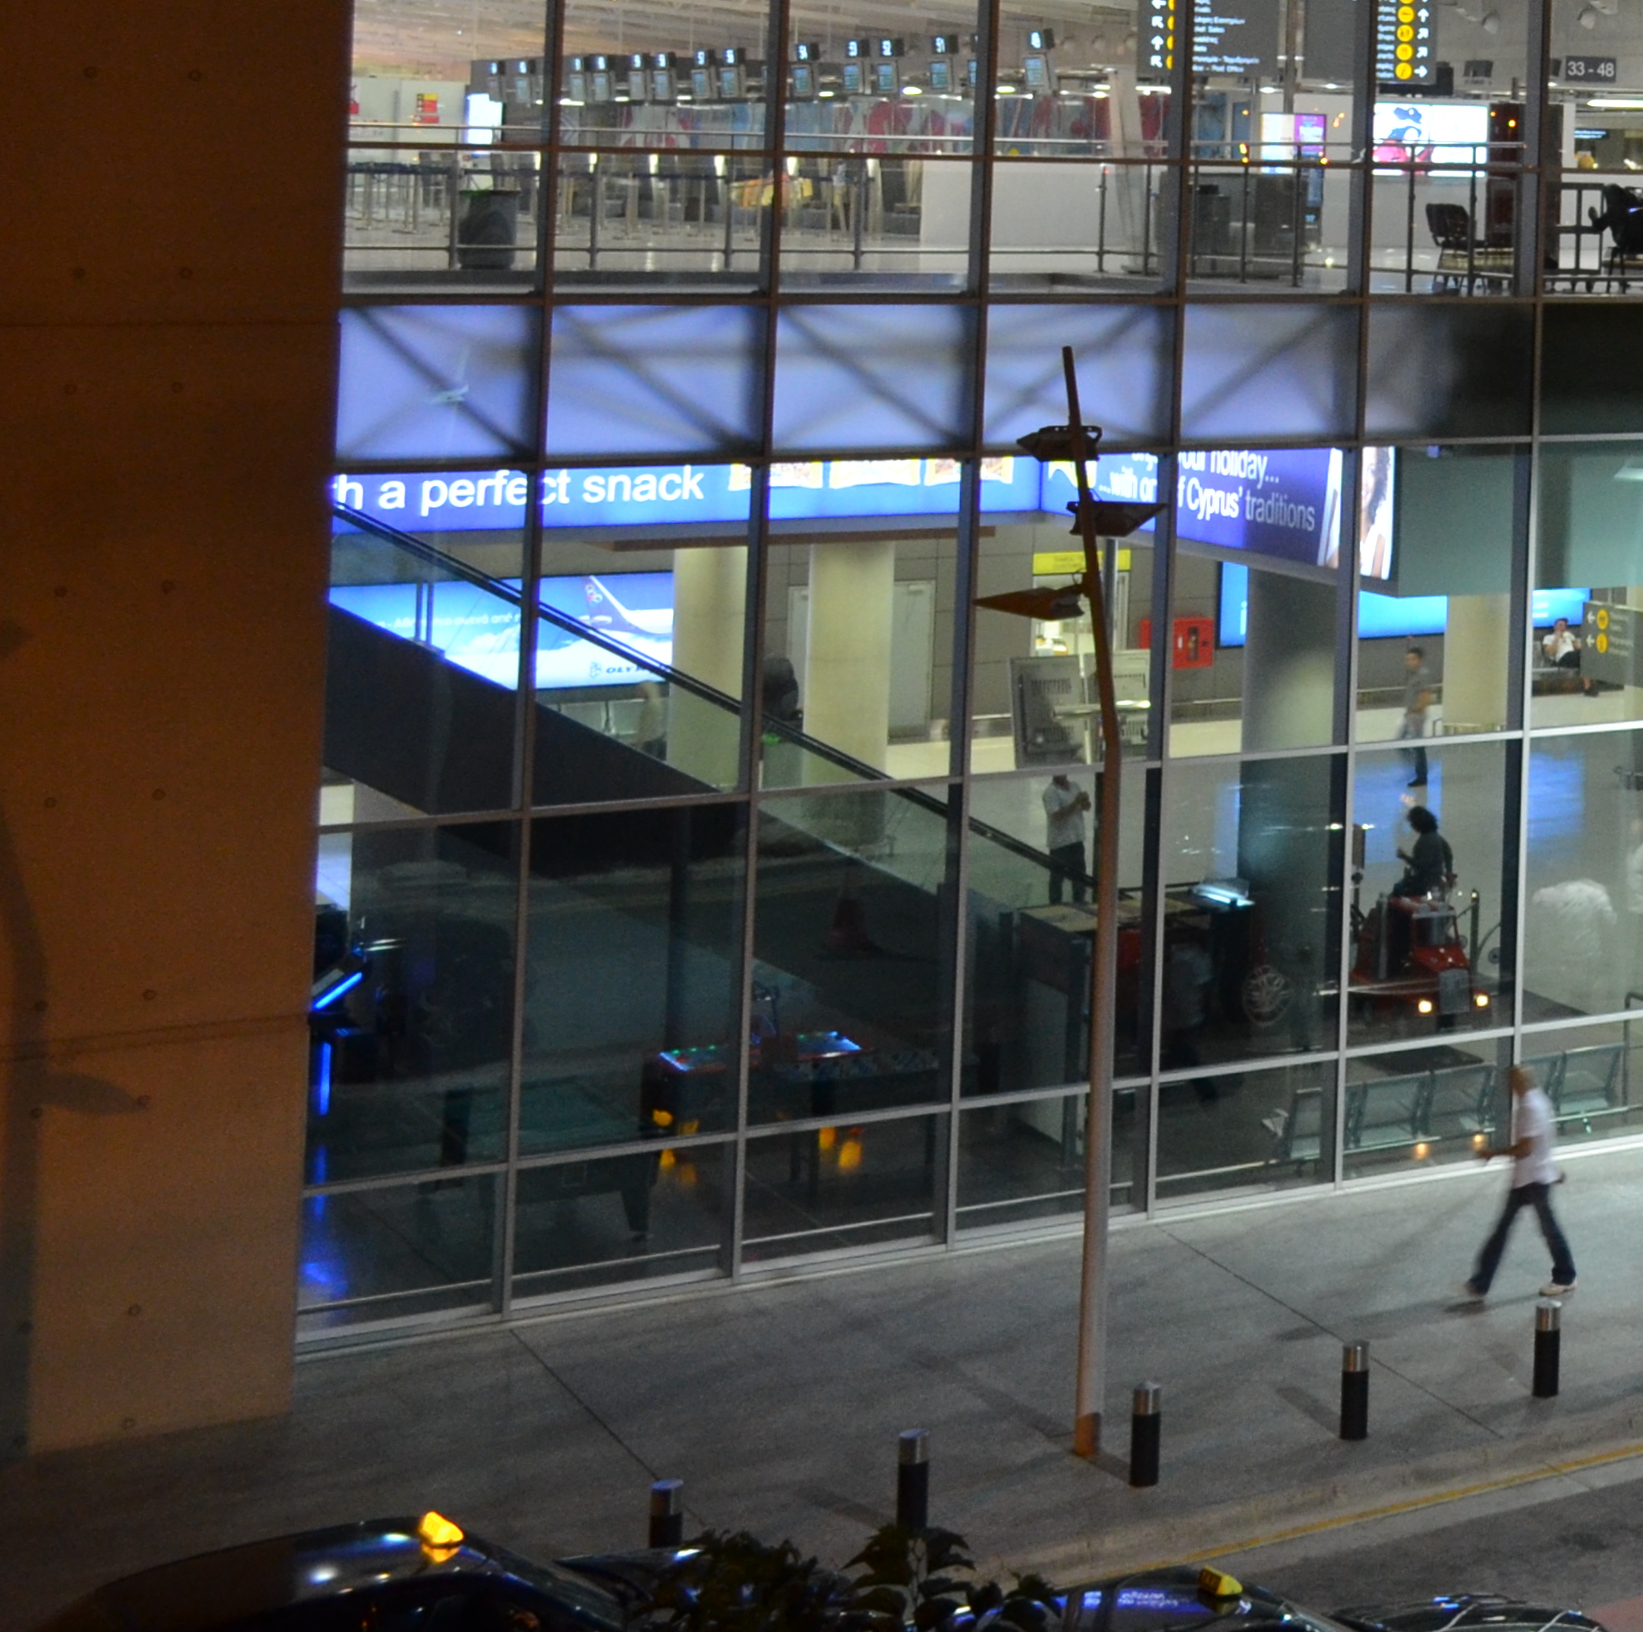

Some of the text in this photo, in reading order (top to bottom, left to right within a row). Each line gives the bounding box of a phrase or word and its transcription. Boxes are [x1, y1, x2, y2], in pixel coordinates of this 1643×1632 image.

[1567, 60, 1585, 77] 33
[1596, 61, 1615, 78] 48
[378, 480, 406, 510] a
[420, 469, 571, 517] perfect
[582, 464, 705, 504] snack
[1244, 490, 1316, 532] traditions
